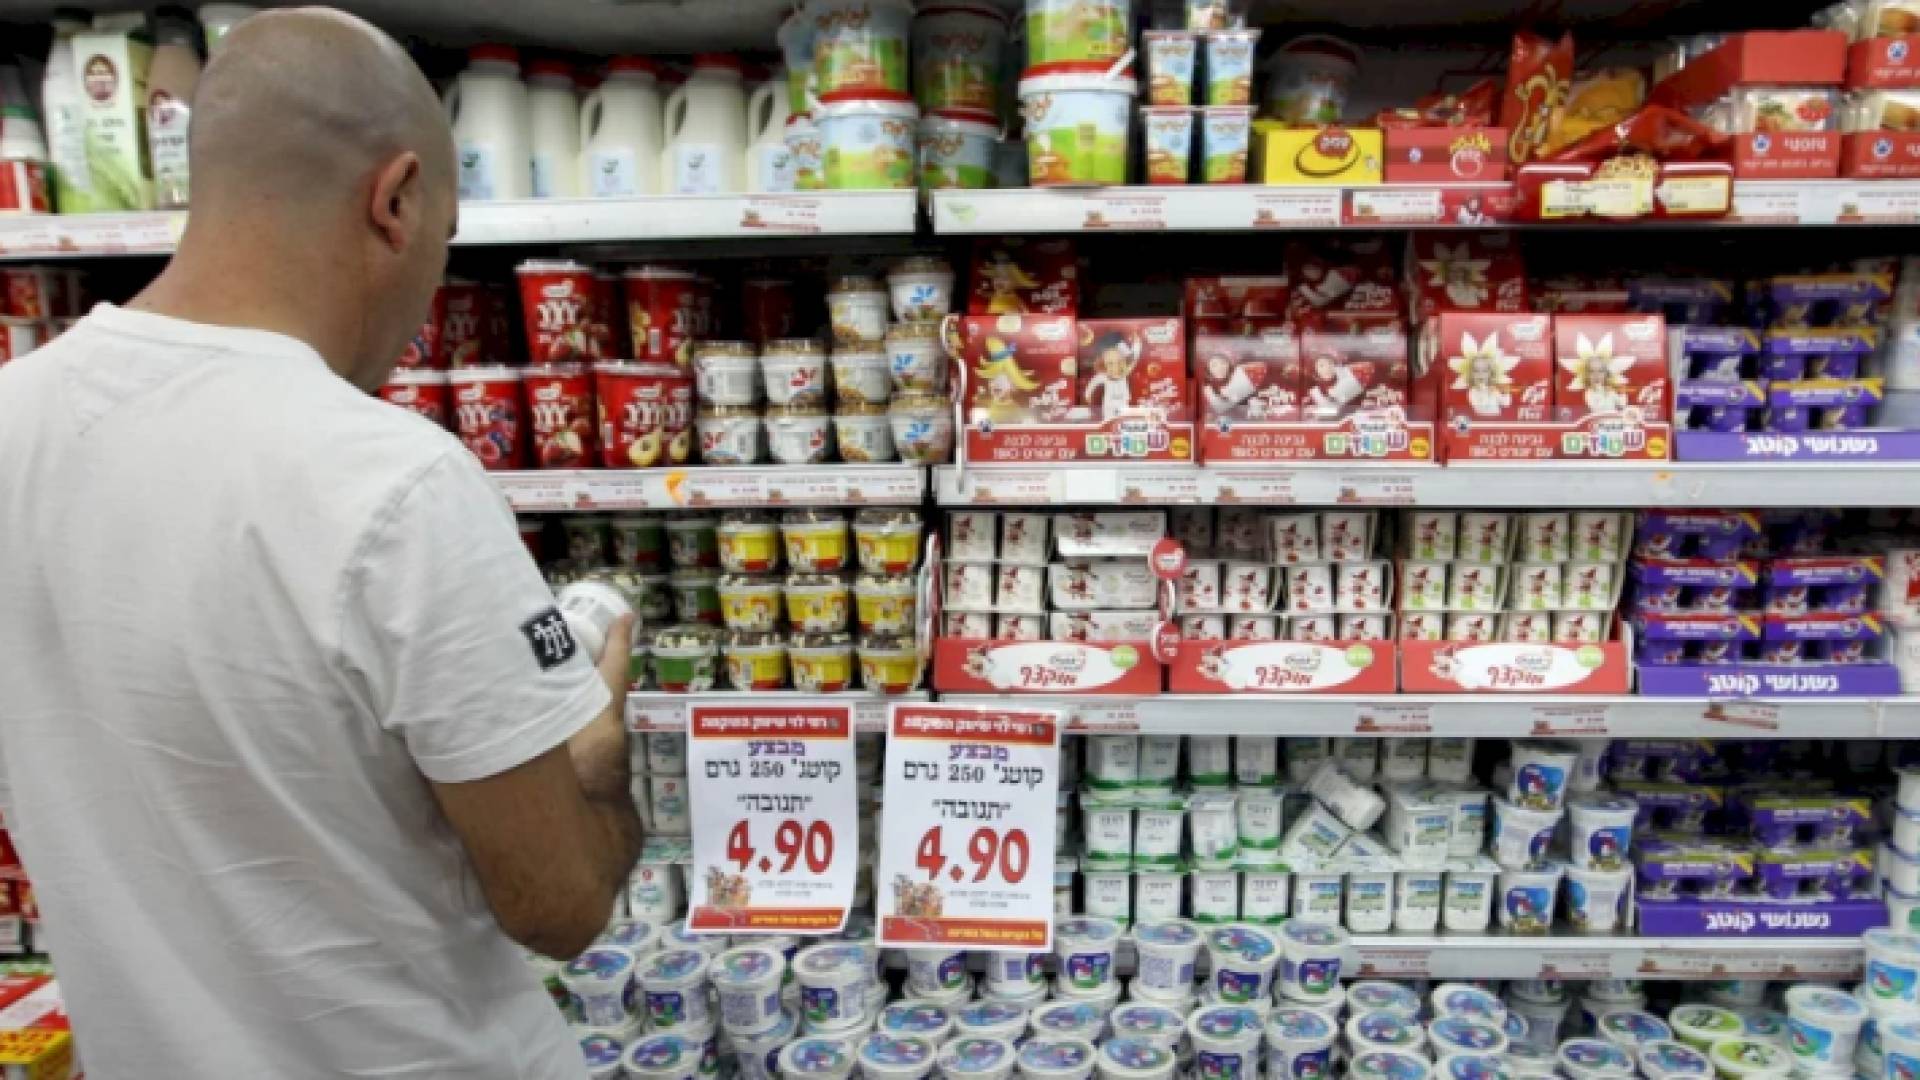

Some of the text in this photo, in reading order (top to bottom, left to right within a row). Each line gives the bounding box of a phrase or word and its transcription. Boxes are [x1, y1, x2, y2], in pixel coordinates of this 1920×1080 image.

[748, 740, 805, 756] מבצע
[949, 744, 1010, 761] מבצע
[705, 759, 740, 778] גרם
[750, 760, 784, 778] 250
[904, 760, 938, 781] גרם
[948, 763, 984, 783] 250
[727, 818, 835, 875] 4.90
[916, 824, 1031, 884] 4.90
